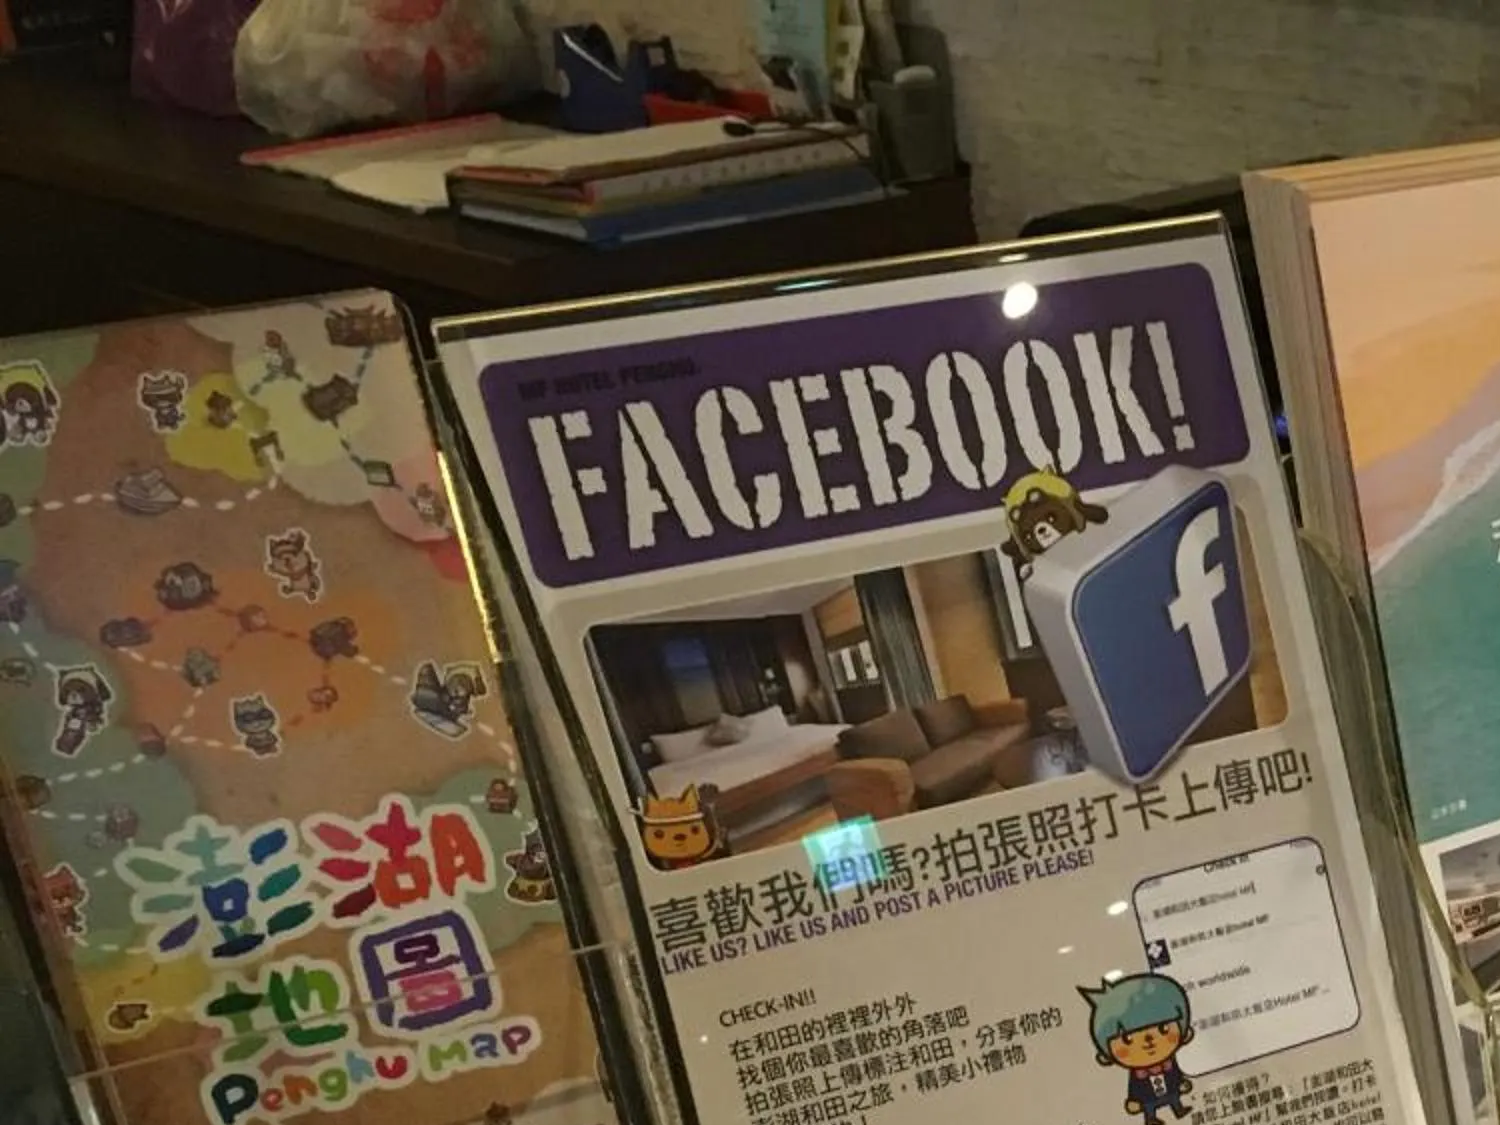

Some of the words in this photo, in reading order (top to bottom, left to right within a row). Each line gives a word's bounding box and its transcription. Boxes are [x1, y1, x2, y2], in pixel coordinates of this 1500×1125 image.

[529, 322, 1195, 560] FACEBOOK!
[128, 801, 486, 959] 澎湖
[661, 951, 707, 975] LIKE
[711, 937, 747, 962] US?
[754, 924, 796, 952] LIKE
[802, 917, 827, 940] US
[831, 903, 870, 932] AND
[876, 892, 921, 921] POST
[926, 889, 941, 908] A
[945, 867, 1020, 901] PICTURE
[1024, 849, 1095, 882] PLEASE!
[207, 910, 494, 1064] 地圖
[719, 988, 817, 1028] CHECK-IN!!
[729, 992, 917, 1064] 在和田的裡裡外外
[211, 1048, 409, 1125] Penghu
